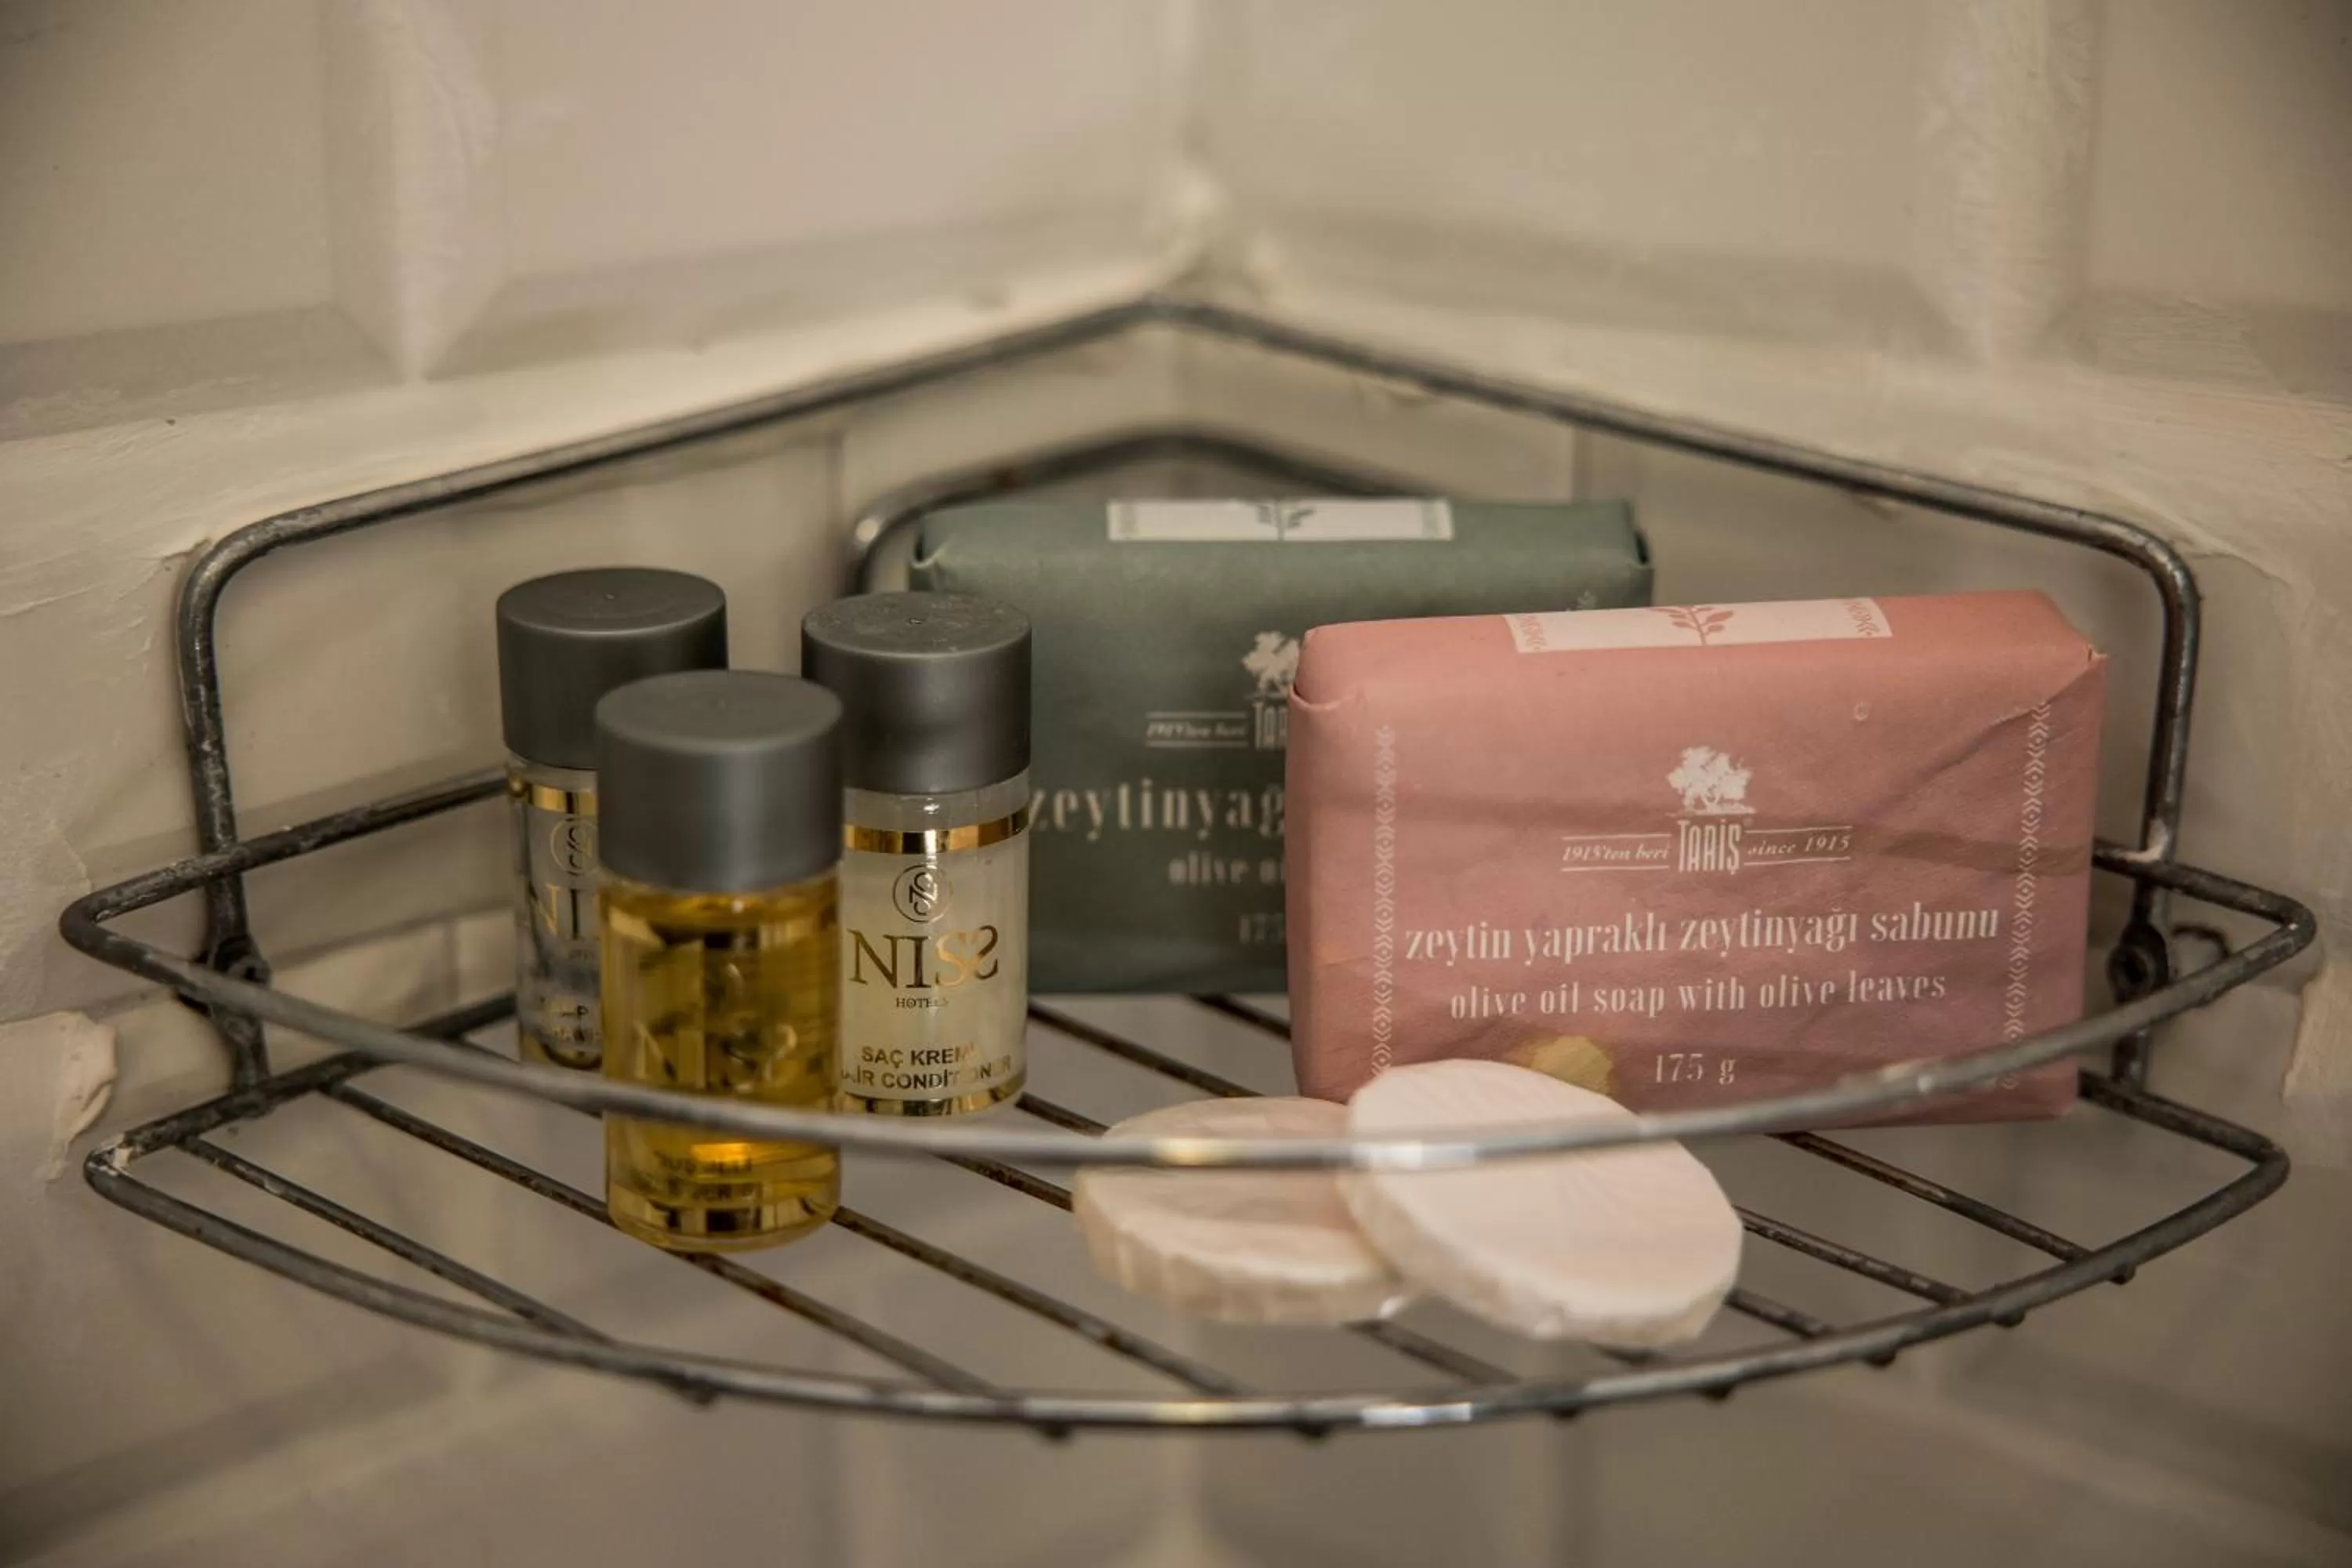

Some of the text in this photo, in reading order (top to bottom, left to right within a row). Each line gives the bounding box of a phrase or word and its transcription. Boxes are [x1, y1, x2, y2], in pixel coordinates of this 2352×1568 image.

[1635, 842, 1670, 861] beri
[1747, 833, 1850, 856] since 1915
[1405, 901, 1999, 967] zeytin yapraklı zeytinyağı sabunu
[1450, 970, 1946, 1019] olive oil soap with olive leaves
[1656, 1052, 1737, 1086] 175 g
